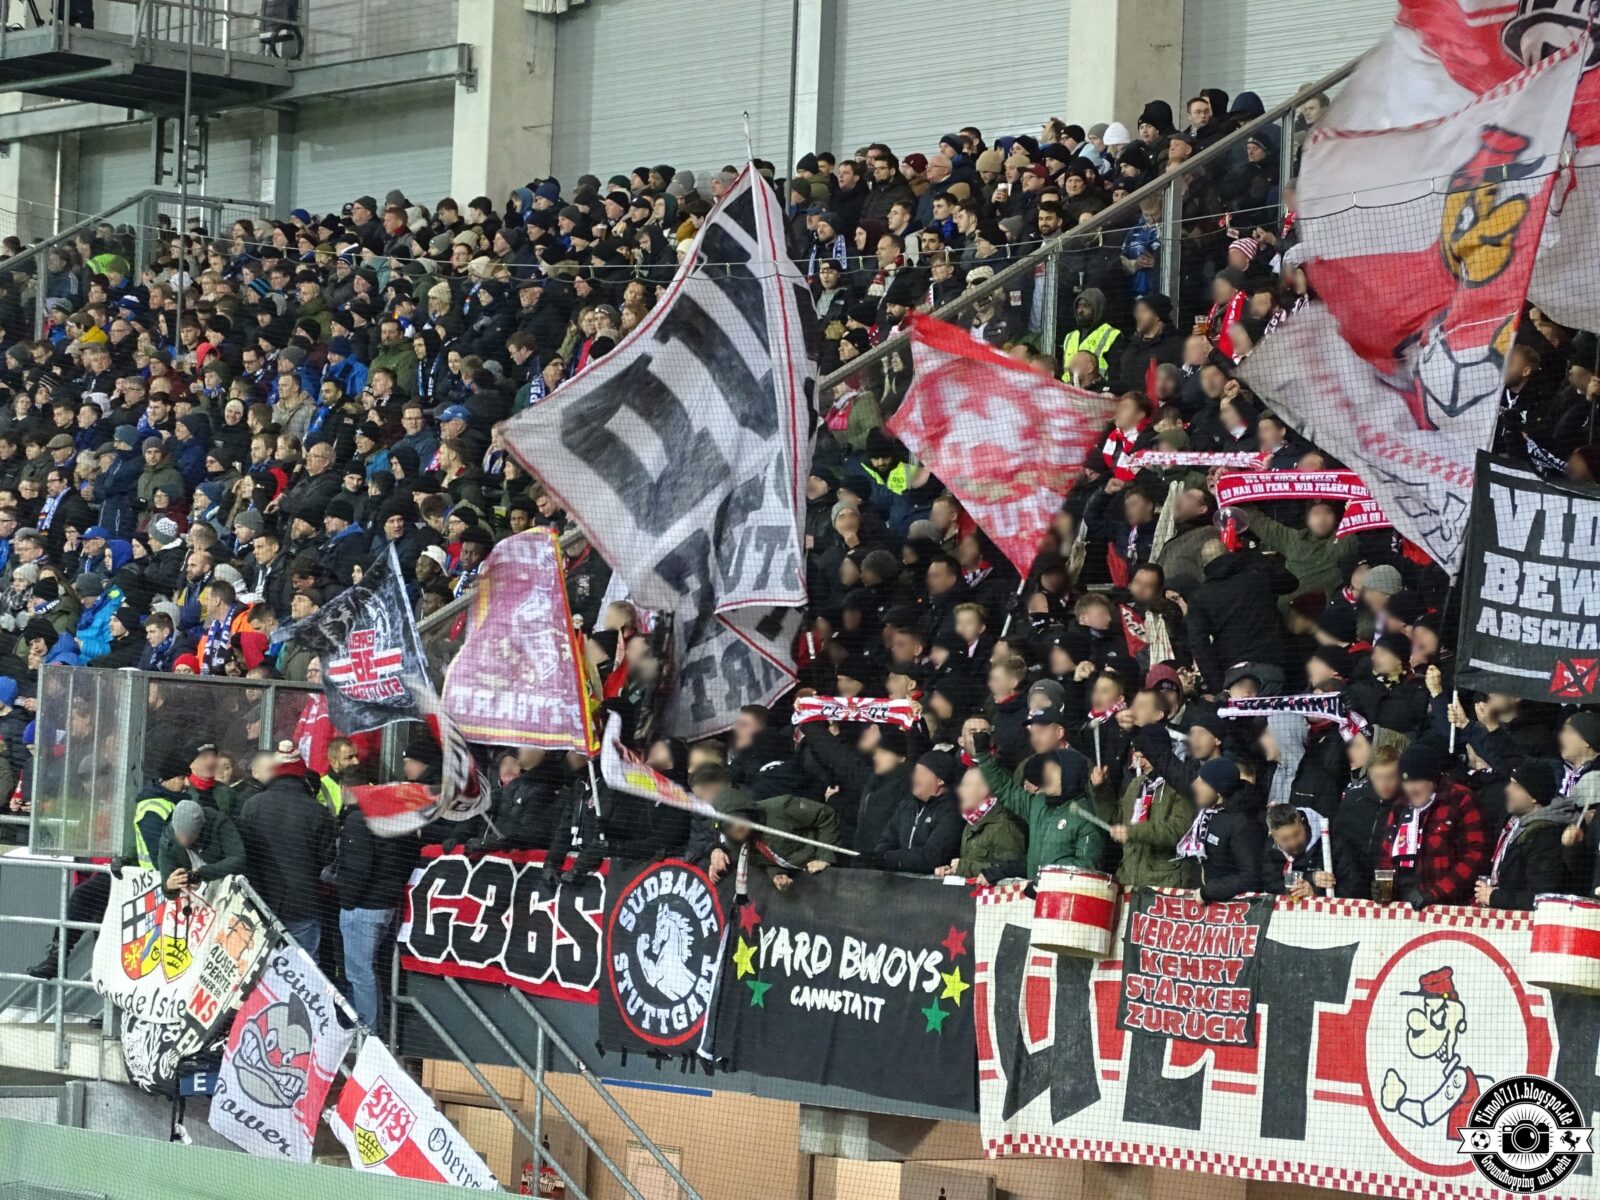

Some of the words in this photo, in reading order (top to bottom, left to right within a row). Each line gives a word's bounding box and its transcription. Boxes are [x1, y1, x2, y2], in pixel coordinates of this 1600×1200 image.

[617, 870, 718, 938] SÜDBANDE
[1147, 895, 1250, 925] JEDER
[1131, 912, 1260, 957] VERBANNTE
[193, 957, 232, 993] PERRTE
[759, 926, 832, 979] YARD
[839, 935, 944, 993] BWOYS
[1140, 948, 1244, 984] KEHRT
[614, 952, 712, 1035] STUTTGART
[790, 985, 886, 1024] CANNSTATT
[1125, 1001, 1247, 1043] ZURÜCK
[194, 1072, 207, 1092] E
